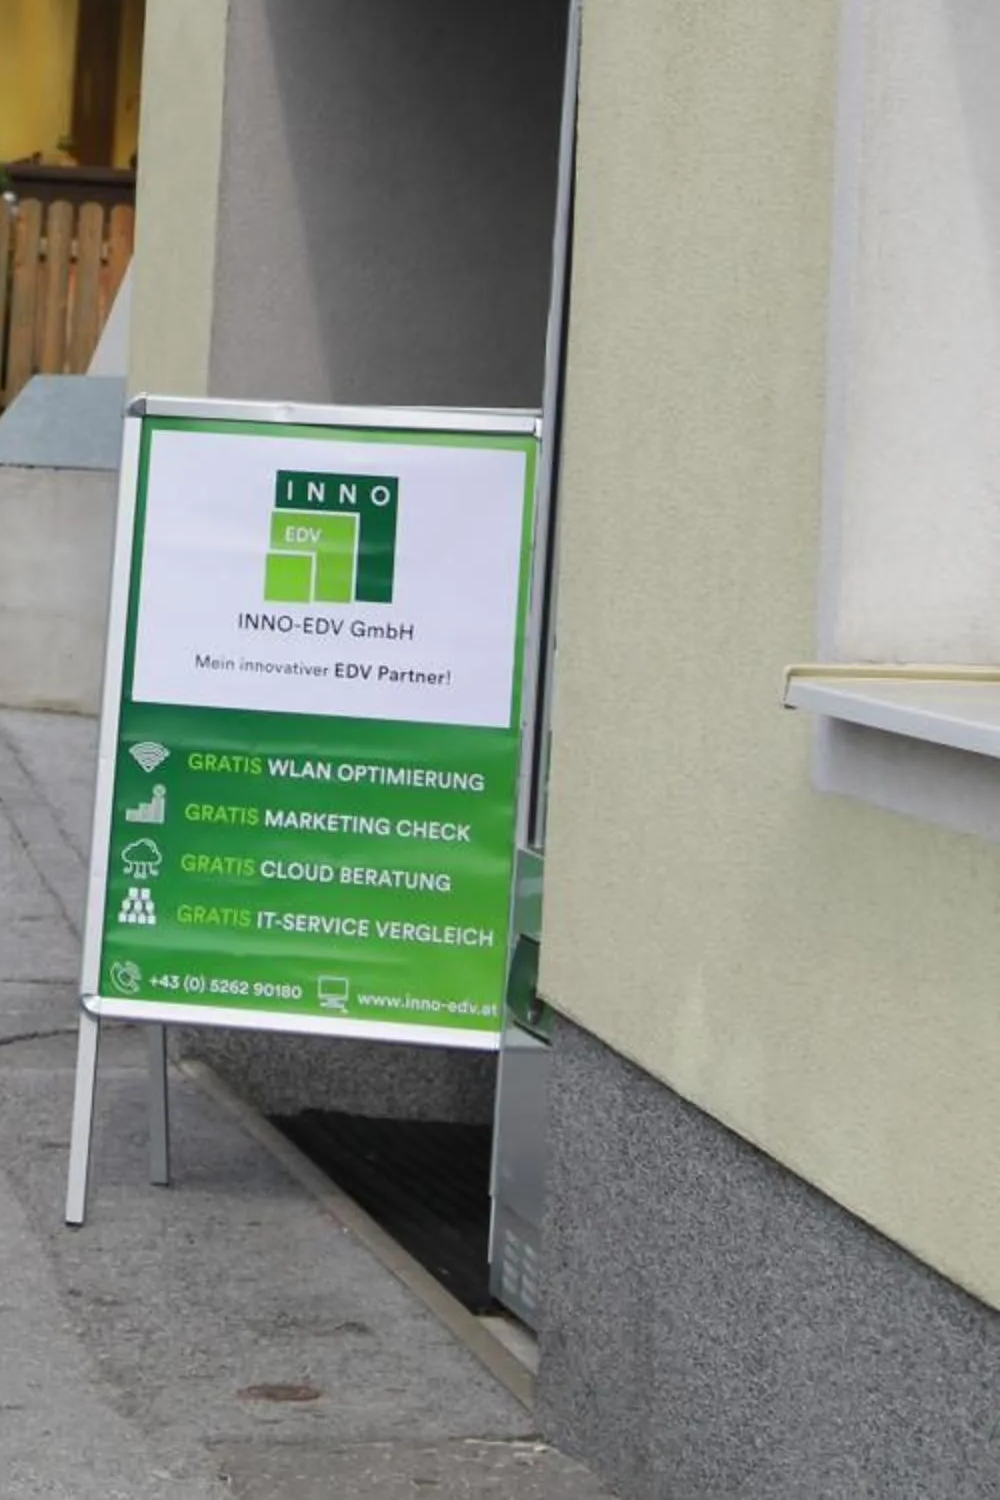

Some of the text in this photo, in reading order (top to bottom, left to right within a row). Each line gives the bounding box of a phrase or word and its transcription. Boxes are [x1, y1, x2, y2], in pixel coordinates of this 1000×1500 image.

[287, 480, 390, 506] INNO
[285, 526, 322, 543] EDV
[238, 612, 414, 641] INNO-EDV GmbH
[194, 654, 451, 686] Mein innovativer EDV Partner!
[188, 753, 485, 791] GRATIS WLAN OPTIMIERUNG
[184, 803, 471, 842] GRATIS MARKETING CHECK
[181, 853, 450, 891] GRATIS CLOUD BERATUNG
[177, 904, 494, 947] GRATIS IT-SERVICE VERGLEICH
[148, 975, 302, 1000] +43 (0) 5262 90180
[357, 992, 498, 1018] www.inno-edv.at
